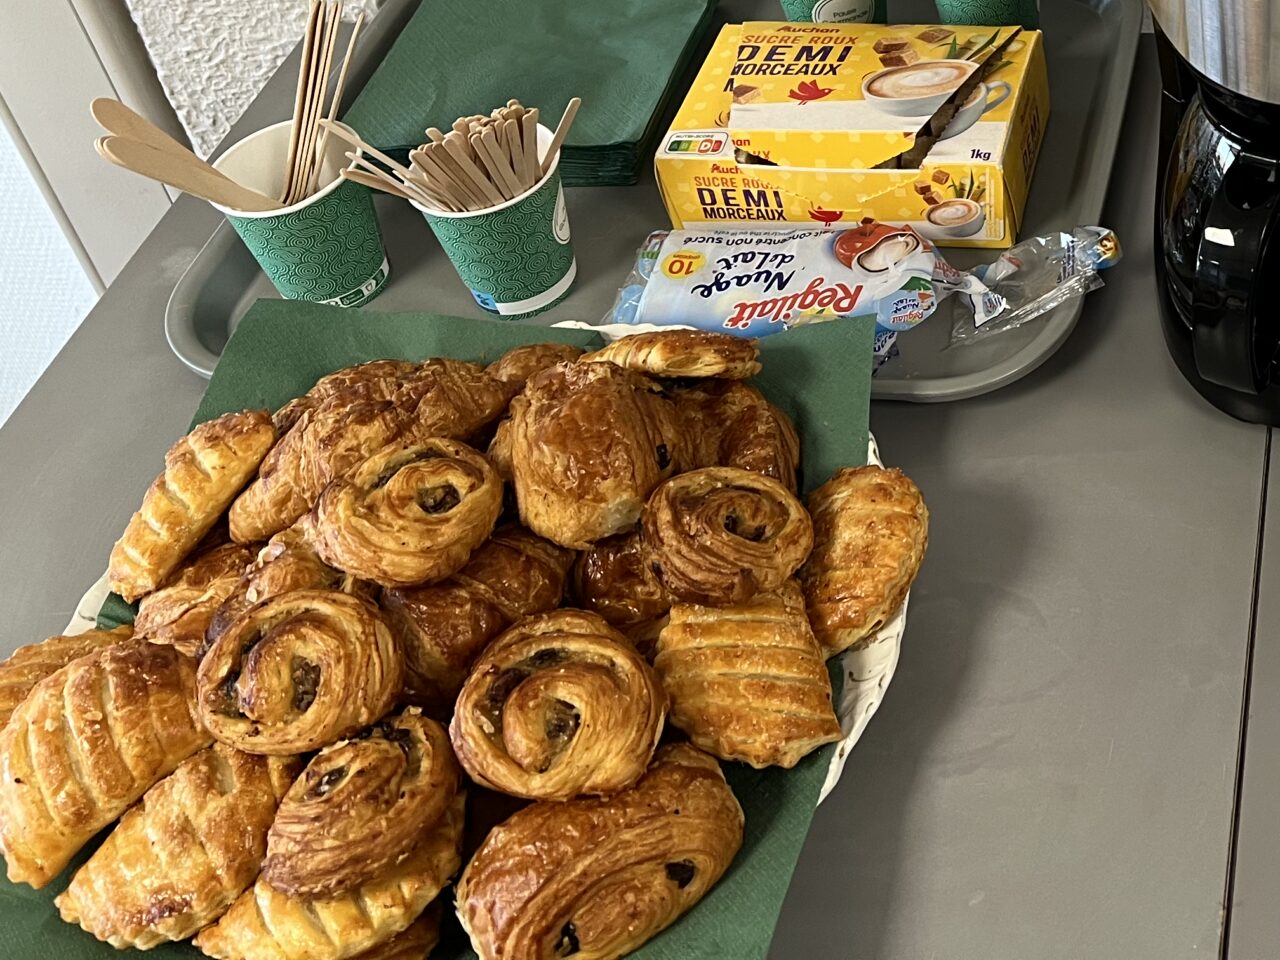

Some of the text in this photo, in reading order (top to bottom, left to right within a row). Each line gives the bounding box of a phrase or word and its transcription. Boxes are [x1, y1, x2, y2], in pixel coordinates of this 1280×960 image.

[776, 25, 841, 34] Auchan
[742, 35, 859, 45] SUCRE ROUX
[737, 45, 853, 62] DEMI
[970, 149, 991, 161] 1kg
[694, 176, 736, 187] SUCRE
[697, 188, 784, 208] DEMI
[703, 207, 787, 220] MORCEAUX
[683, 236, 724, 246] sucré
[725, 238, 754, 246] non
[668, 260, 694, 275] 10
[691, 270, 796, 299] Nuage
